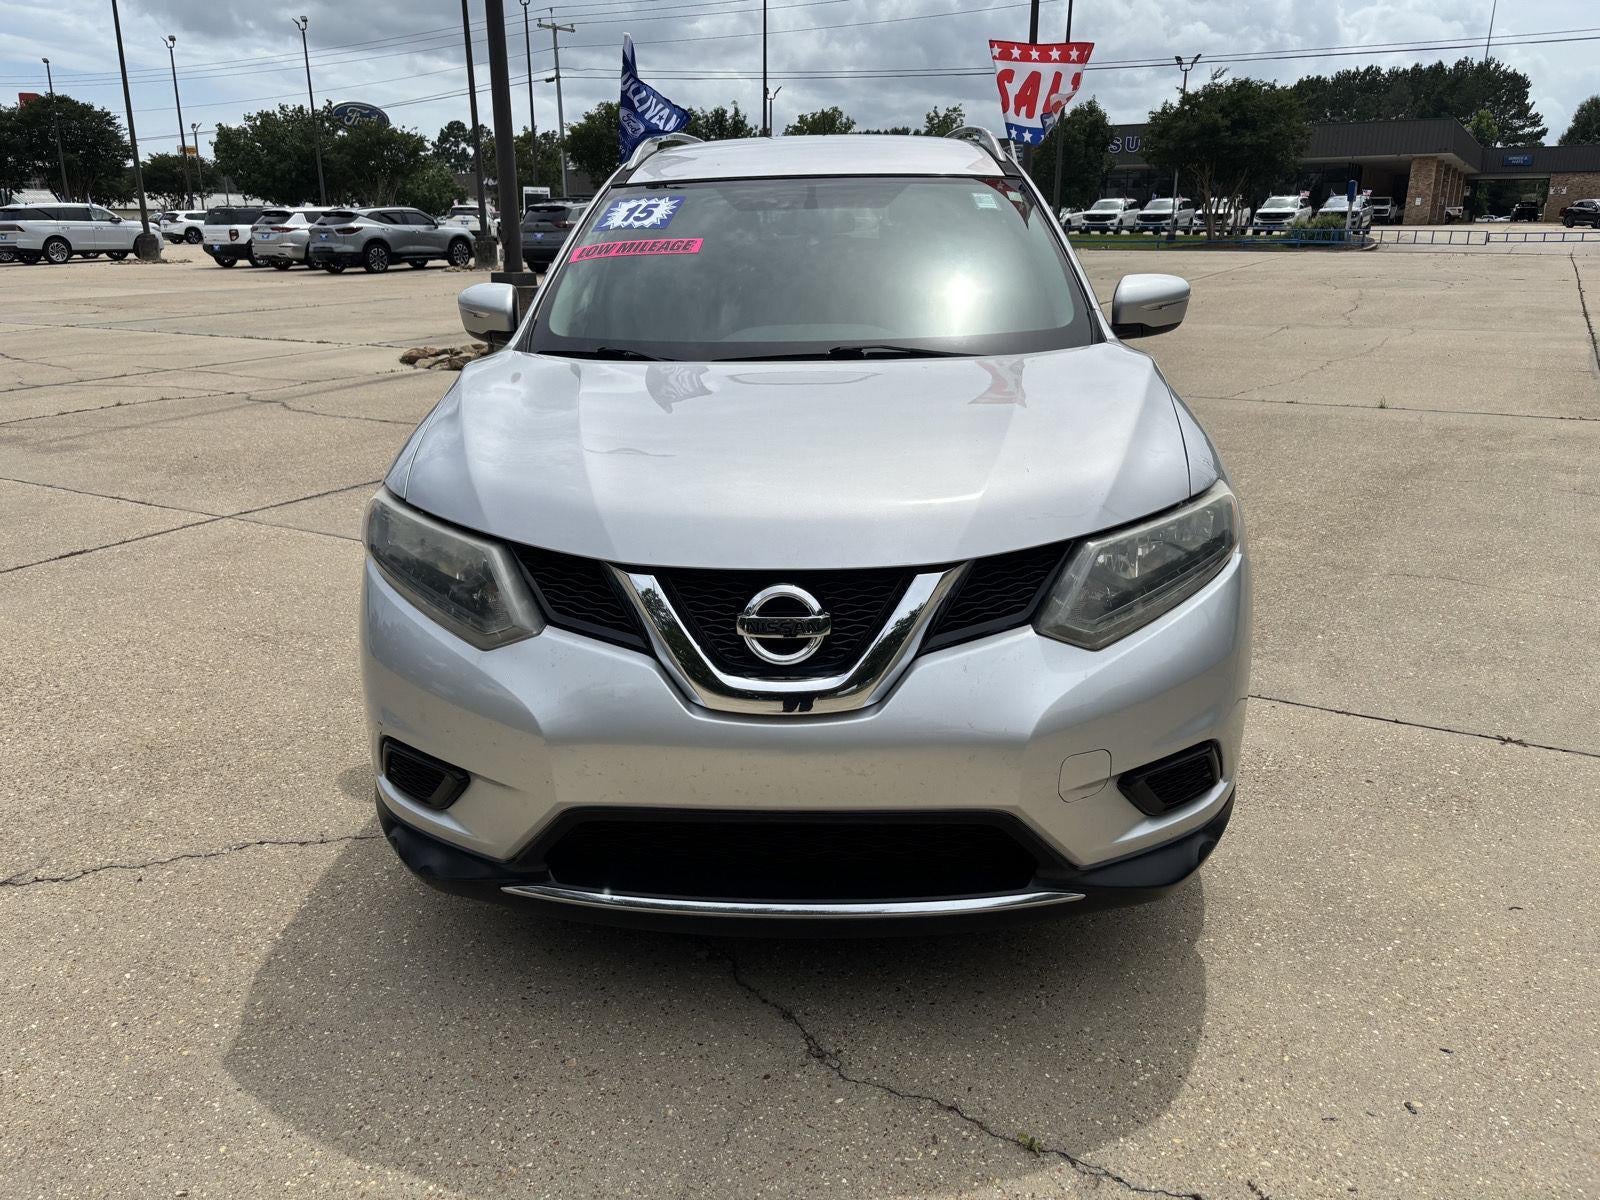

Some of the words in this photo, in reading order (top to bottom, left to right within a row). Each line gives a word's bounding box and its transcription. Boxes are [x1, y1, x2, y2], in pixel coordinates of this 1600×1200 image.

[621, 203, 660, 222] 15
[577, 243, 617, 258] LOW
[616, 239, 697, 254] MILEAGE
[748, 621, 819, 634] NISSAN
